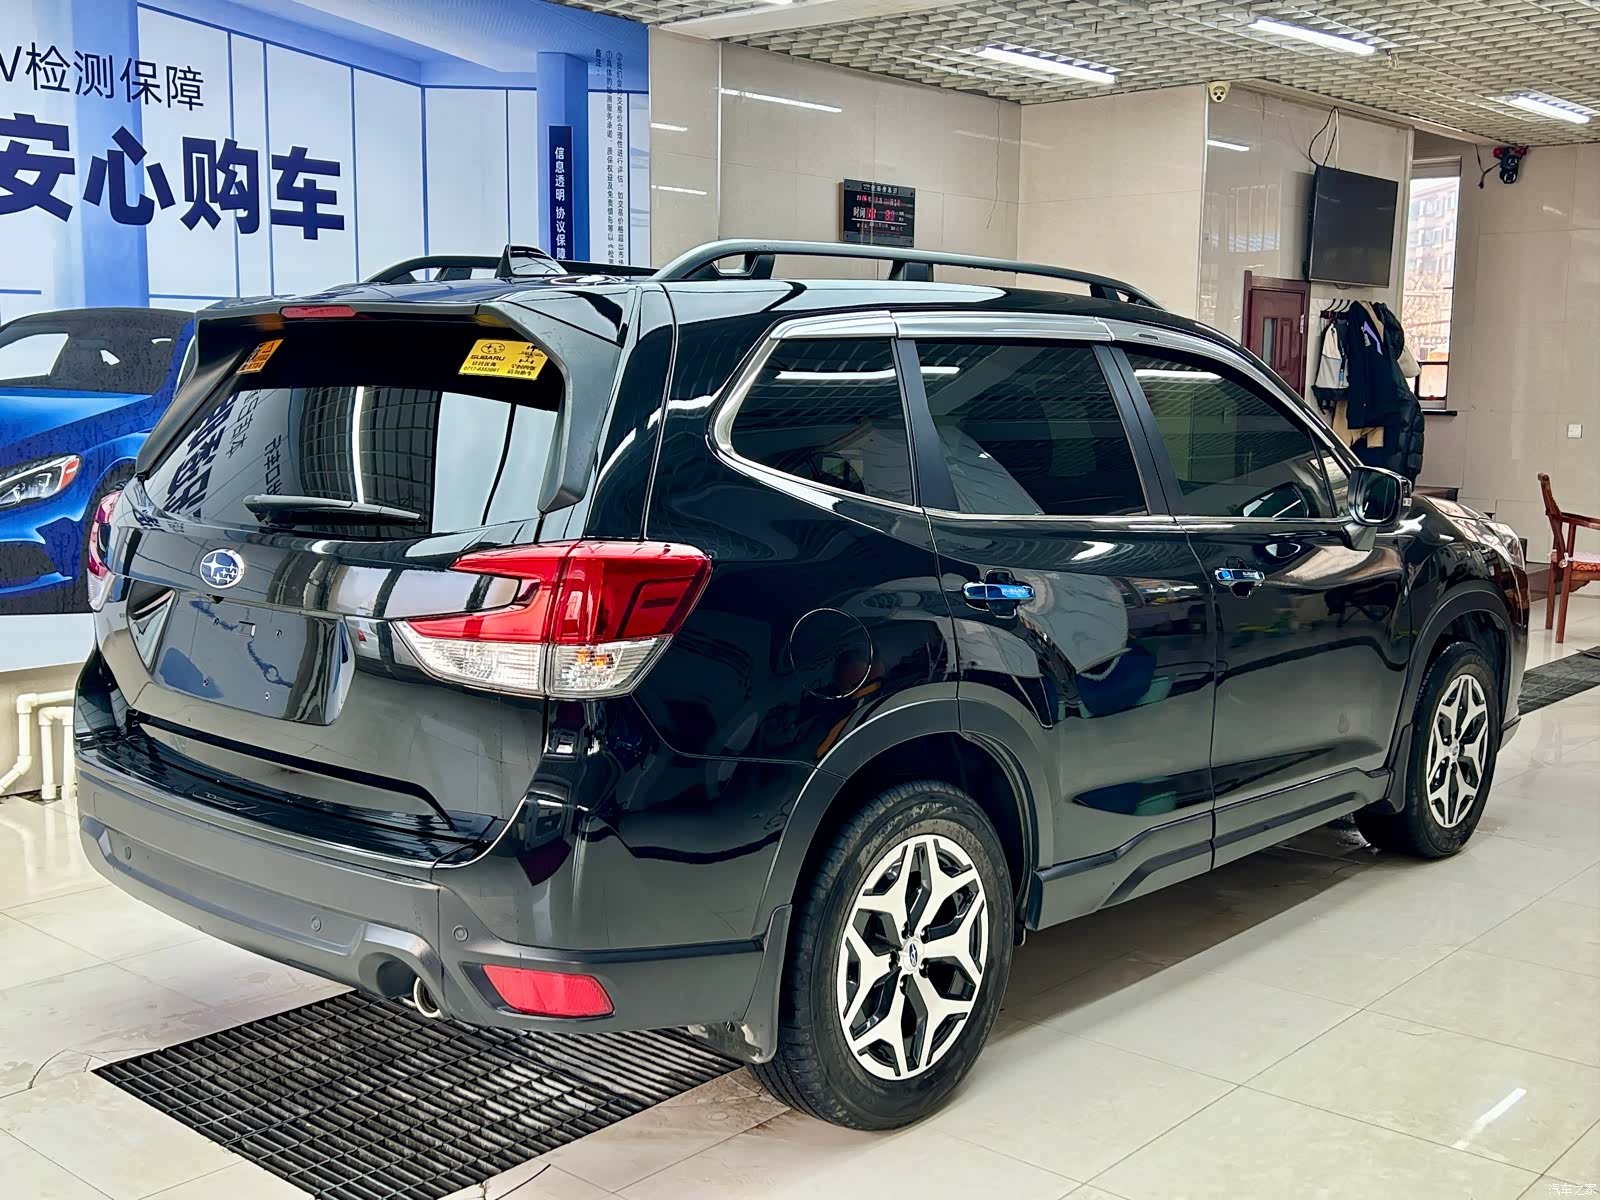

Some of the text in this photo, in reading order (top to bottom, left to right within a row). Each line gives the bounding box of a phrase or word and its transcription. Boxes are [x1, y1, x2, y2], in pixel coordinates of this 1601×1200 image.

[0, 113, 346, 241] 安心购车
[554, 146, 567, 260] 信息透明 协议保障
